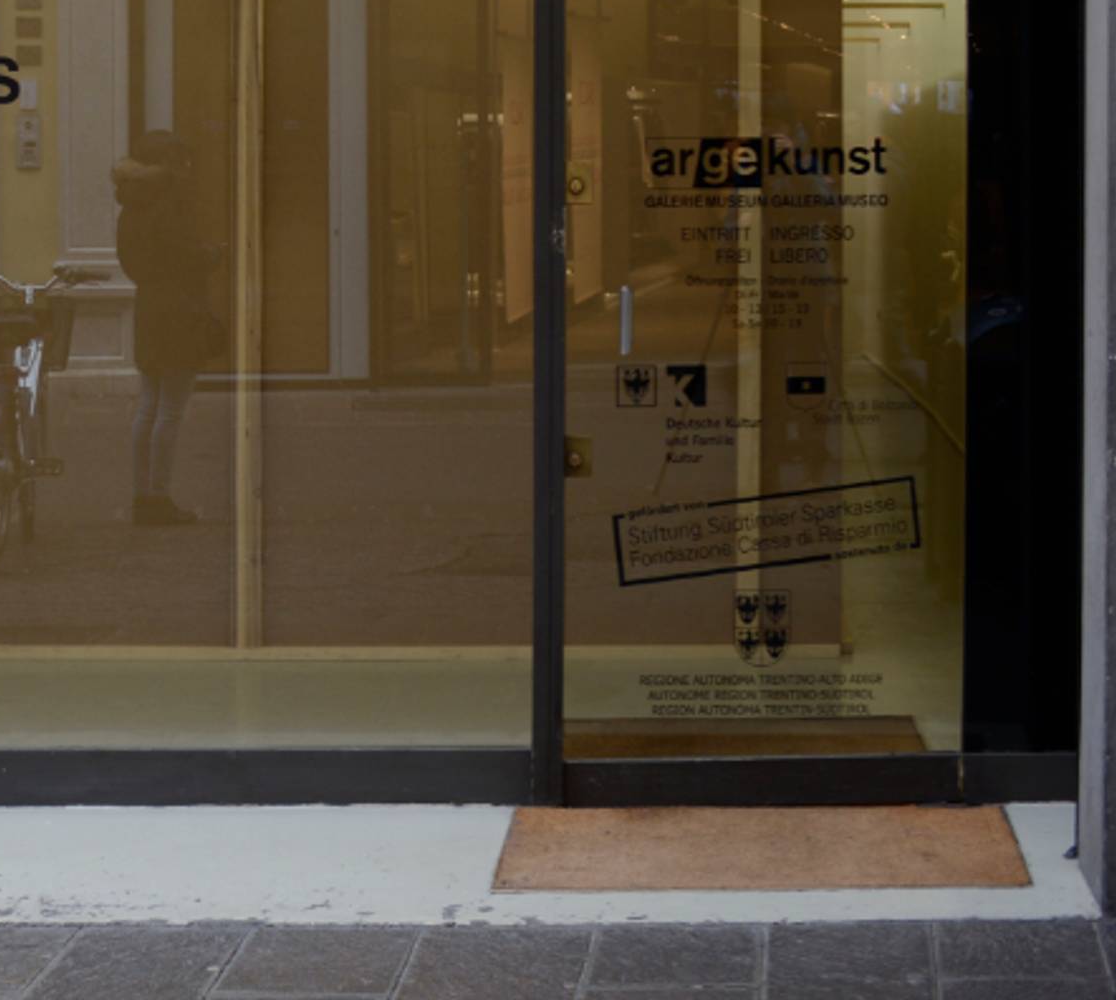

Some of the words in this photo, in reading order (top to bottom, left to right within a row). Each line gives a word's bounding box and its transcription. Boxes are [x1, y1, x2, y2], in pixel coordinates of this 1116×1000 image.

[644, 195, 704, 209] GALERIE
[680, 226, 751, 242] EINTRITT
[769, 225, 854, 242] INGRESSO
[715, 248, 752, 264] FREI
[769, 248, 829, 264] LIBERO
[666, 416, 721, 430] Deutsche
[666, 451, 703, 464] Kultur
[627, 523, 702, 547] Stiftung
[801, 498, 896, 525] Sparkasse
[628, 543, 733, 569] Fondazione
[818, 517, 908, 544] Risparmio
